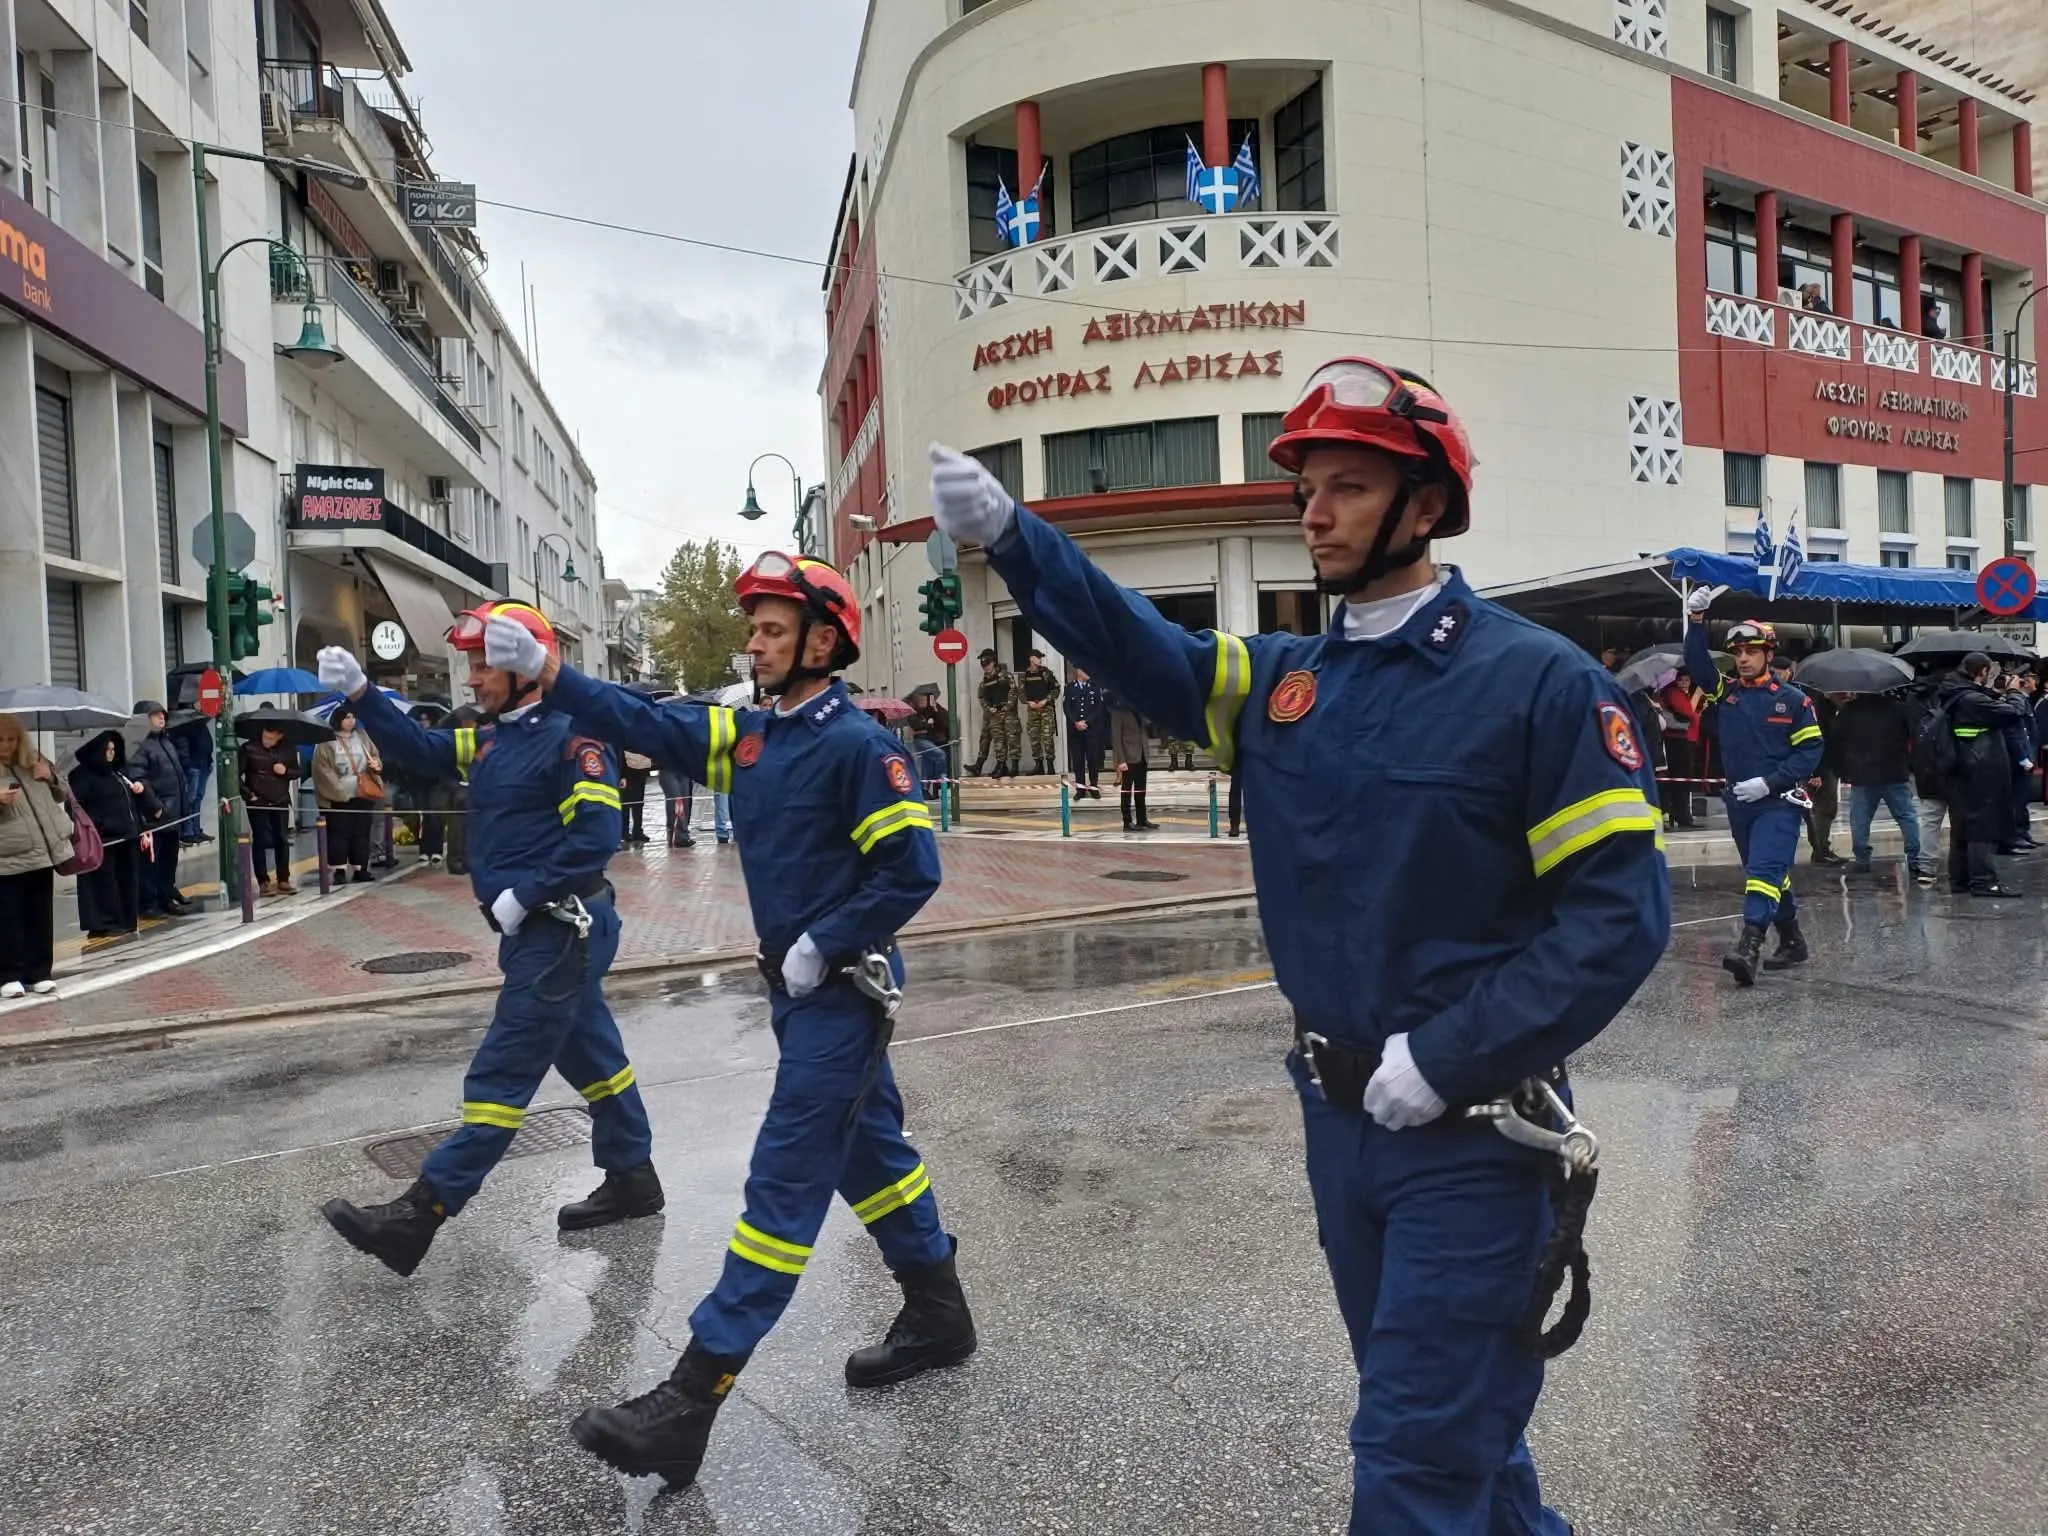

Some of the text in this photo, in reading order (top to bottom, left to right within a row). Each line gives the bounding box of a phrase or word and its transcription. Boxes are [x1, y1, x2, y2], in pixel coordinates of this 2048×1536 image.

[23, 272, 52, 312] bank
[973, 299, 1306, 372] ΛΕΣΧΗ ΑΞΙΩΜΑΤΙΚΩΝ
[987, 349, 1283, 410] ΦΡΟΥΡΑΣ ΛΑΡΙΣΑΣ
[1815, 379, 1970, 422] ΛΕΣΧΗ ΑΞΙΩΜΑΤΙΚΩΝ
[1827, 415, 1960, 452] ΦΡΟΥΡΑΣ ΛΑΡΙΣΑΣ
[306, 475, 373, 491] Night Club
